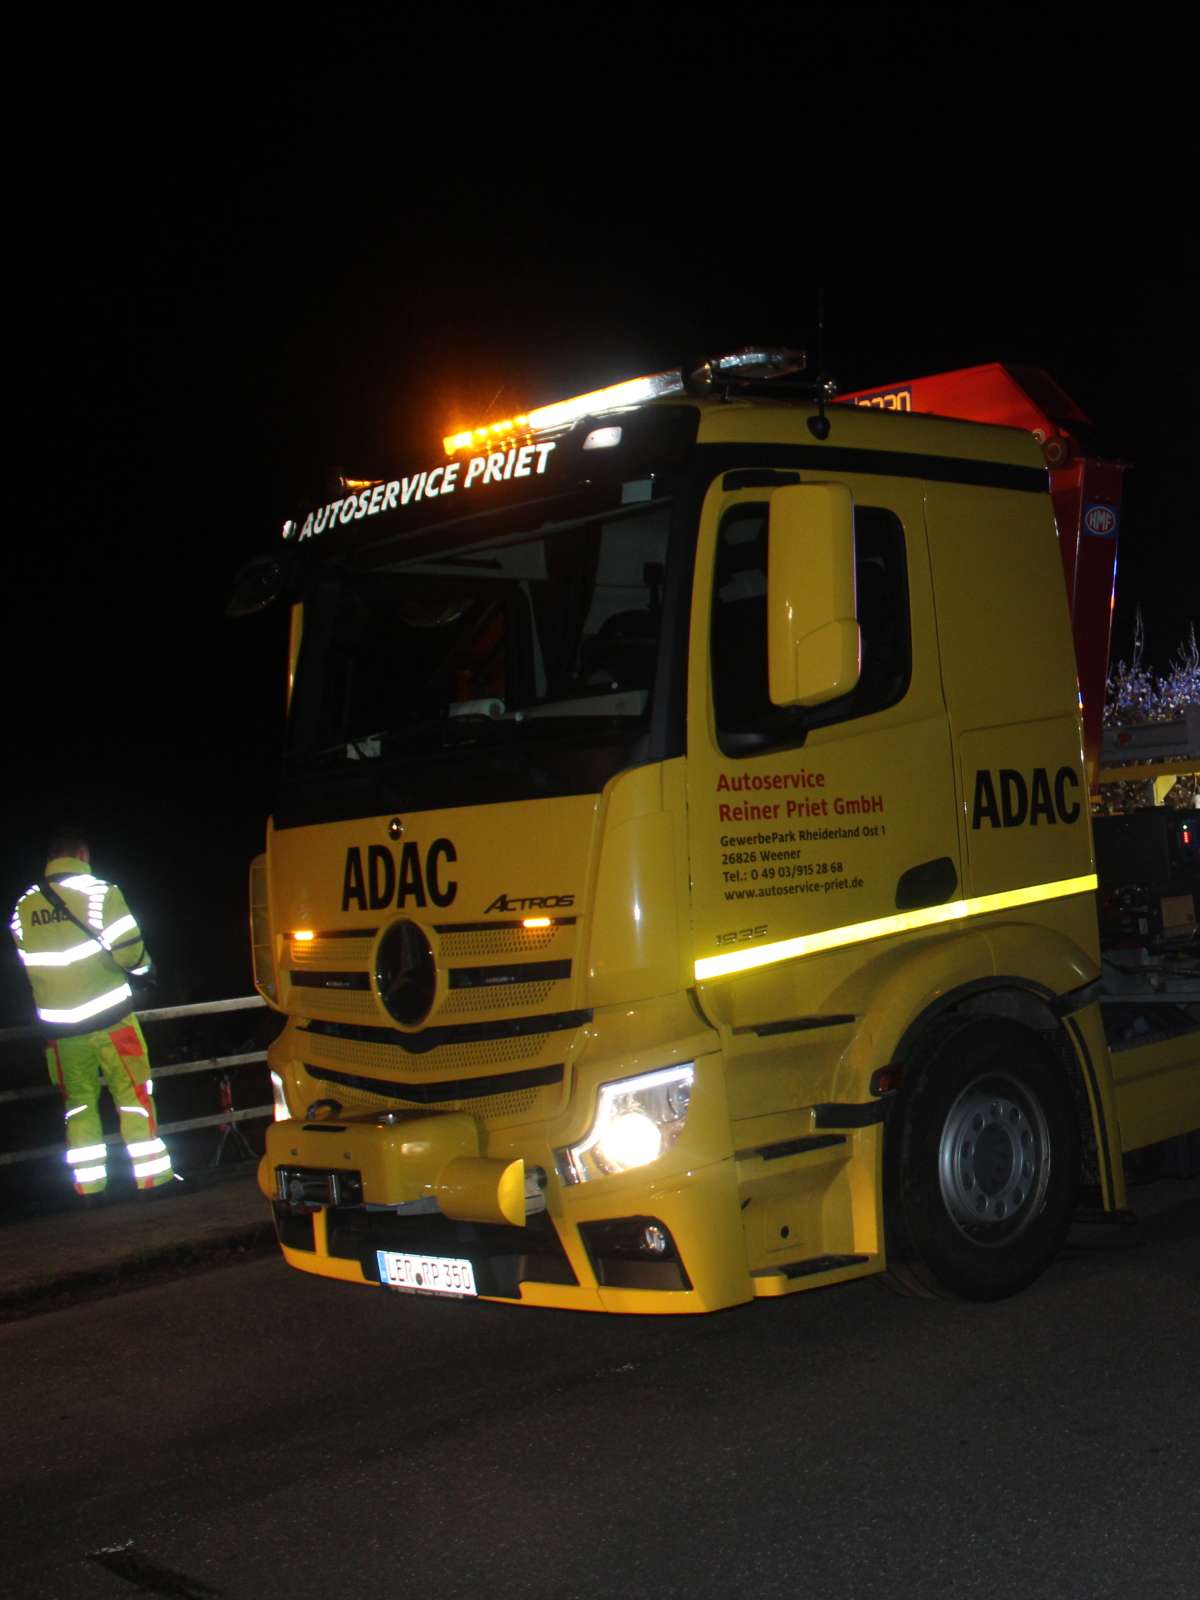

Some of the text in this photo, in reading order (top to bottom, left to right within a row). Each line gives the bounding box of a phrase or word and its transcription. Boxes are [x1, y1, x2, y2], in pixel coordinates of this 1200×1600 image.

[298, 442, 556, 542] AUTOSERVICE PRIET
[1088, 510, 1112, 530] HMF
[716, 769, 825, 792] Autoservice
[719, 795, 884, 822] Reiner Priet GmbH
[972, 766, 1081, 830] ADAC
[720, 825, 886, 847] GewerbePark Rheiderland Ost 1
[721, 849, 801, 865] 26826 Weener
[341, 837, 457, 912] ADAC
[723, 861, 843, 883] Tel.: 0 49 03/915 28 68
[724, 876, 864, 901] www.autoservice-priet.de
